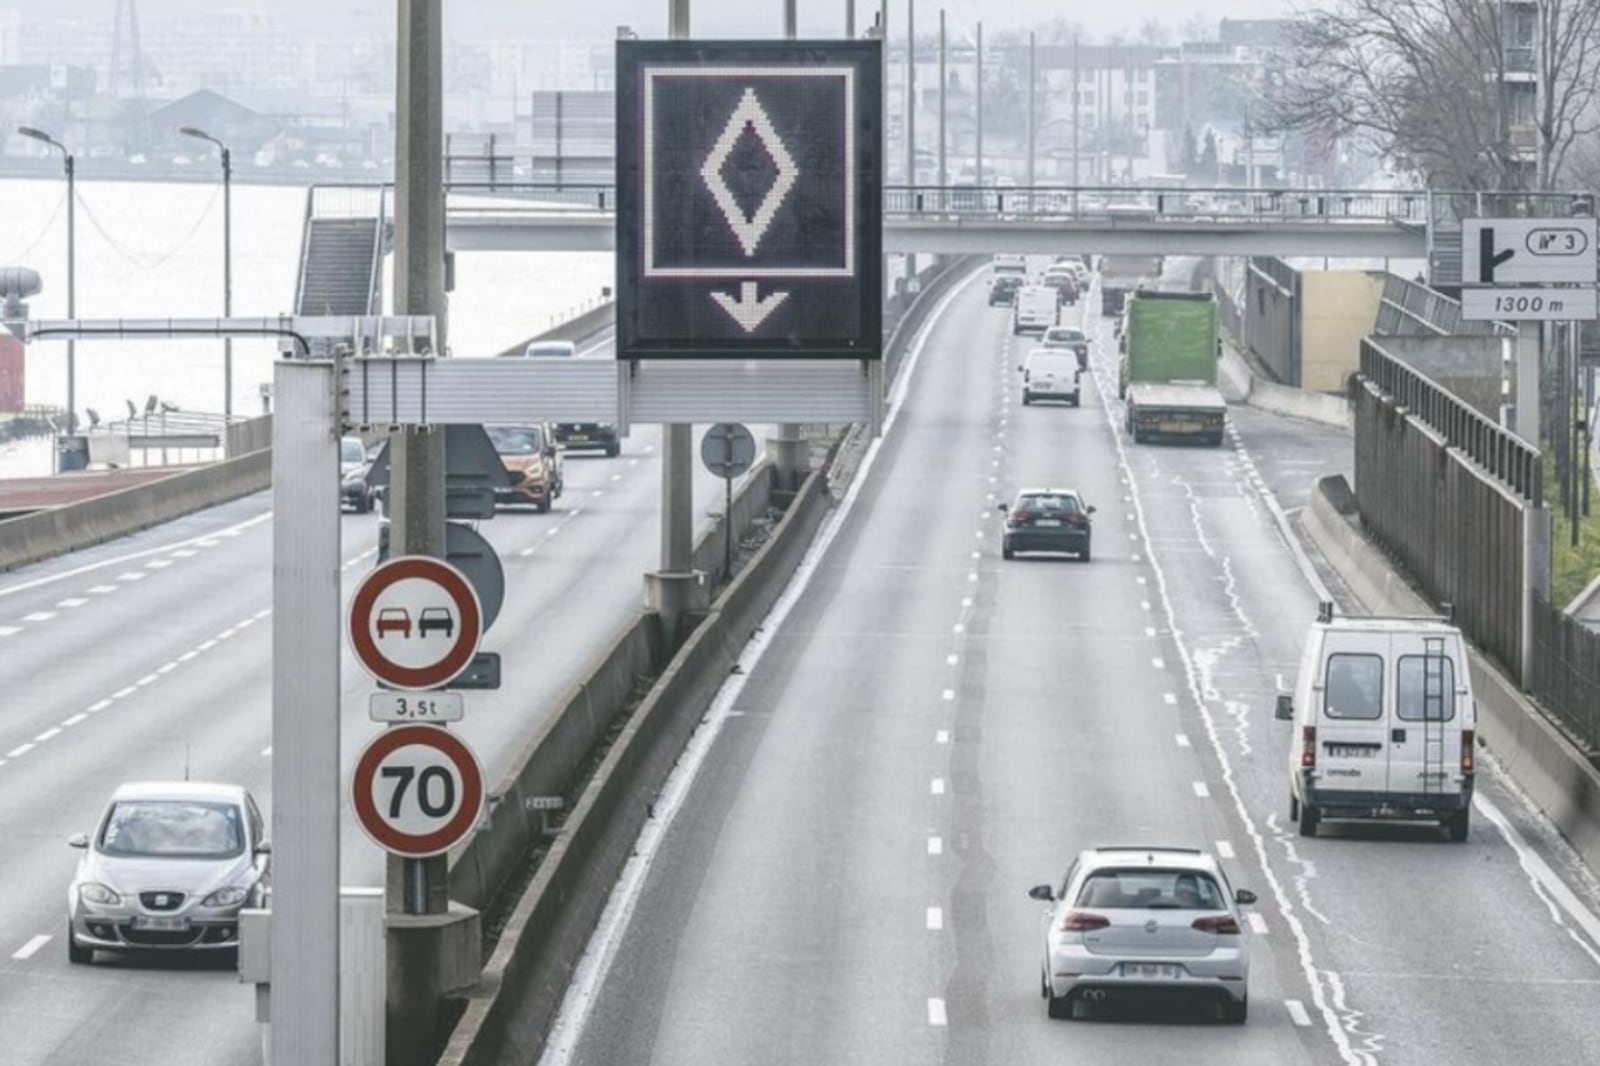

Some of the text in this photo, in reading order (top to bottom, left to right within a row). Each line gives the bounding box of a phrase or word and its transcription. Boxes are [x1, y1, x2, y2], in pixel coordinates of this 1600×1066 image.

[1565, 234, 1576, 250] 3
[1495, 296, 1564, 312] 1300 m
[396, 698, 437, 718] 3,5t
[381, 765, 456, 819] 70
